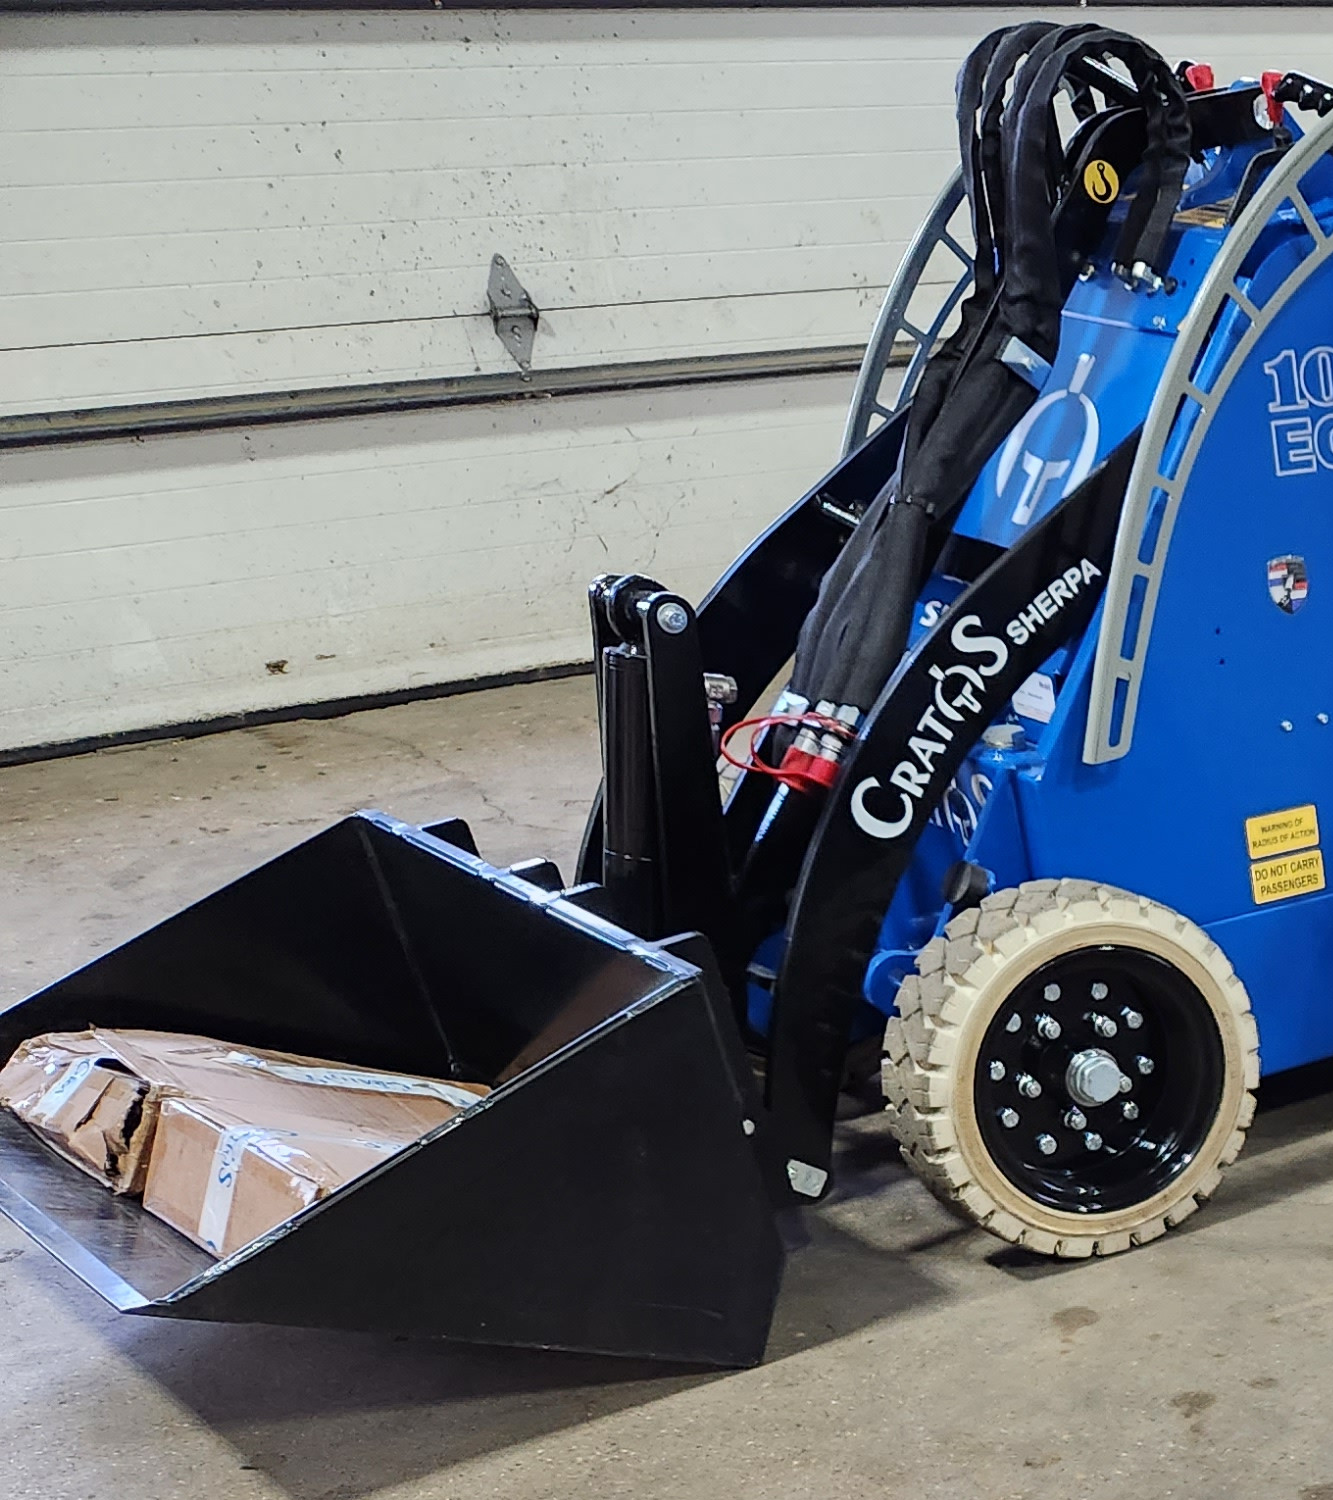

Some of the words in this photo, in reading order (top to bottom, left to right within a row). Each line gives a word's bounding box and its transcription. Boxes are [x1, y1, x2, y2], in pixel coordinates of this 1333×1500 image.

[1006, 557, 1102, 645] SHERPA
[1260, 820, 1293, 834] WARNING
[1295, 817, 1303, 828] OF
[1252, 835, 1278, 849] RADIUS
[1280, 834, 1289, 844] OF
[1290, 828, 1316, 841] ACTION
[1255, 868, 1268, 881] DO
[1270, 864, 1288, 878] NOT
[1290, 856, 1320, 877] CARRY
[1260, 873, 1319, 896] PASSENGERS
